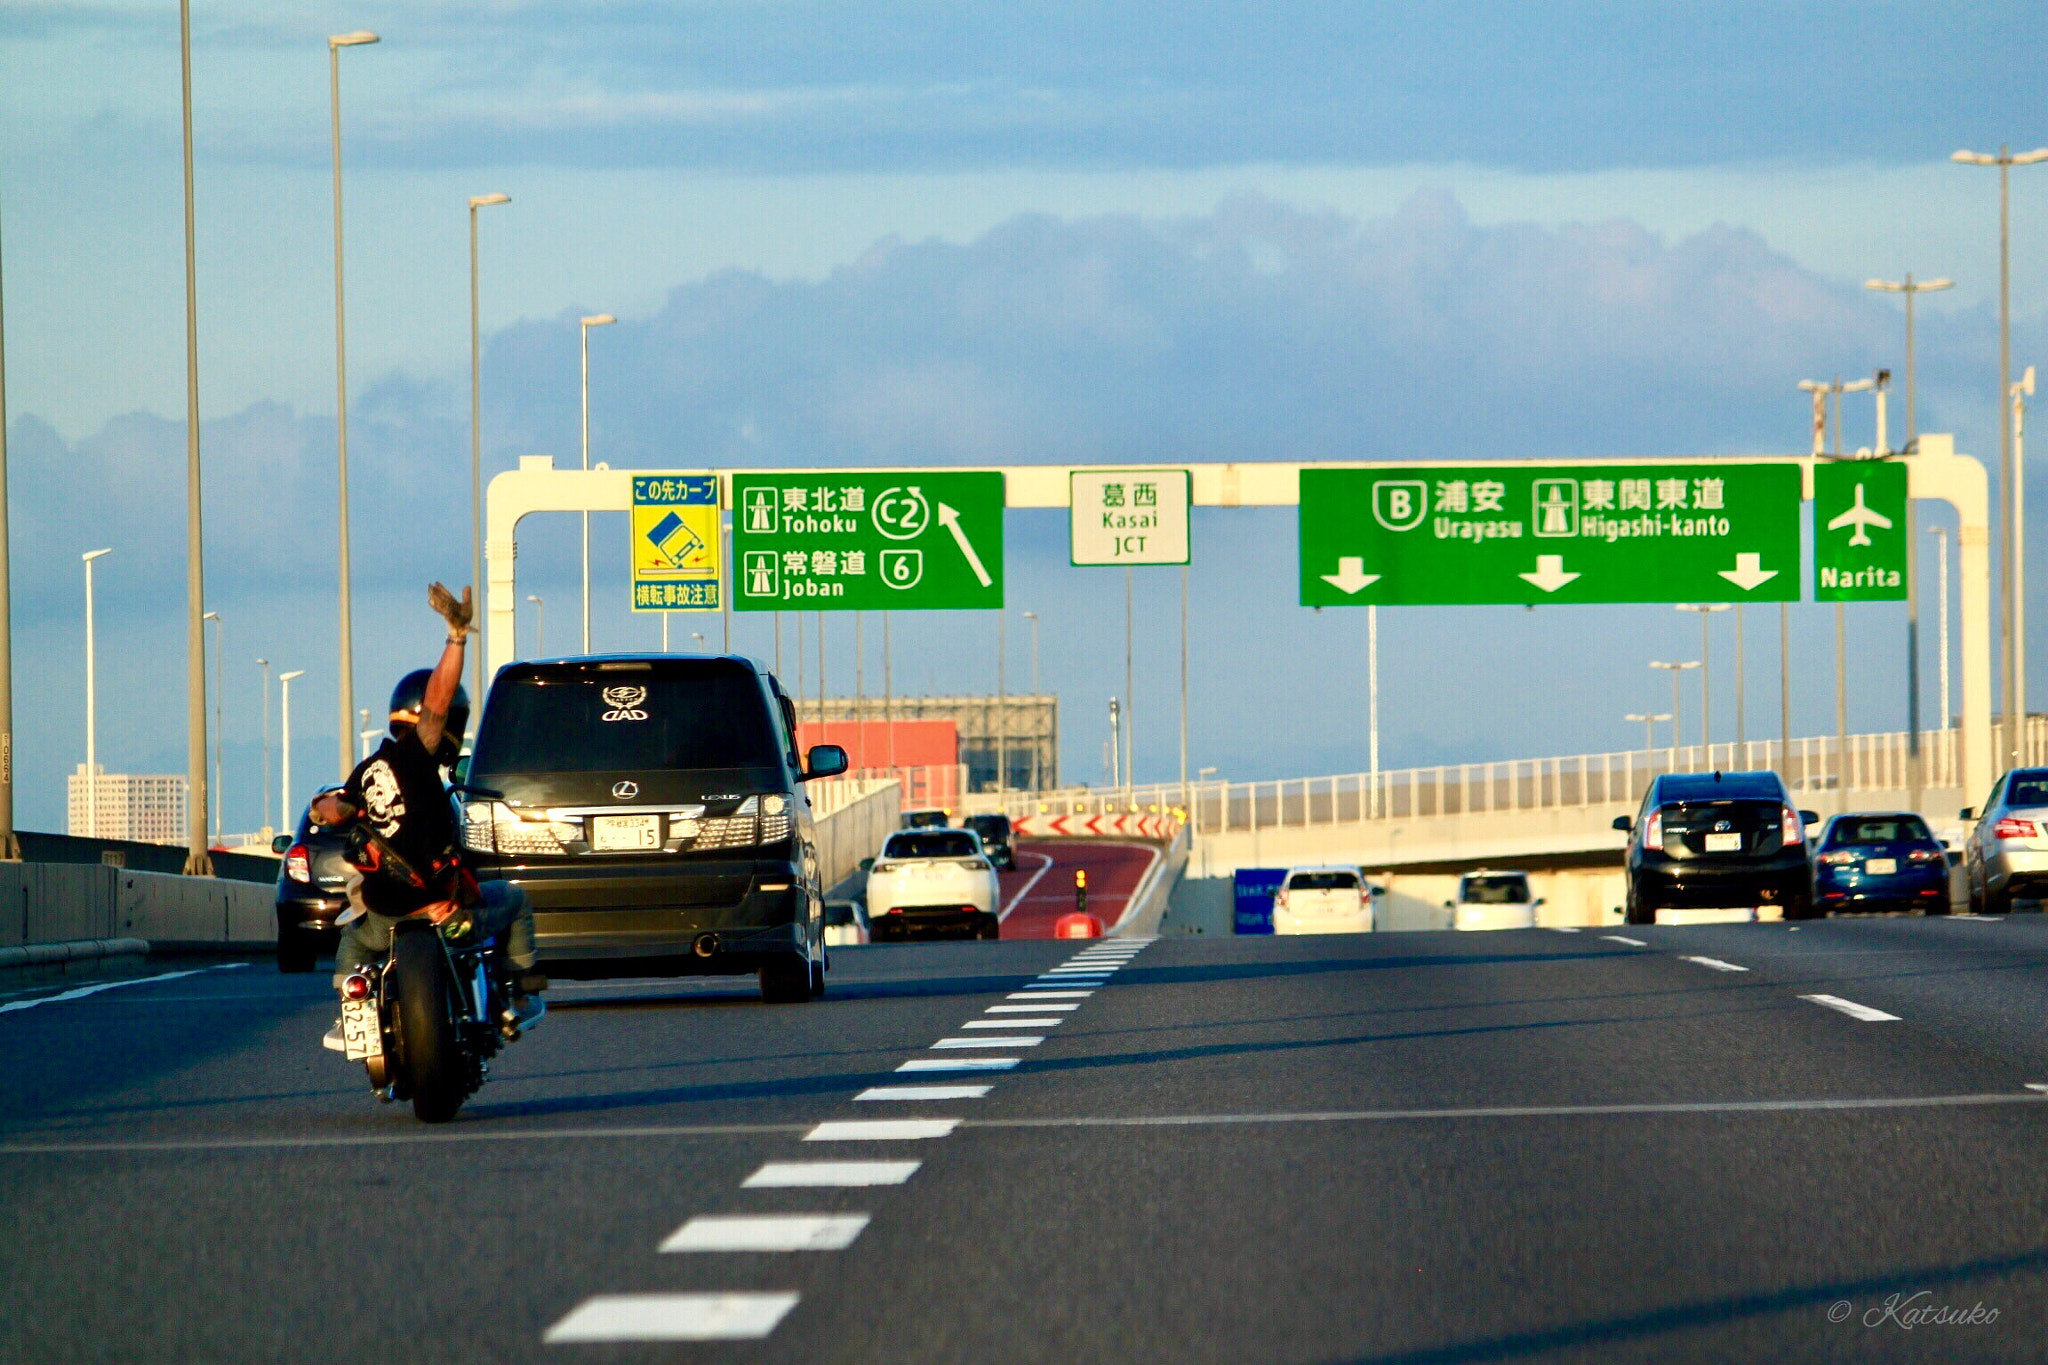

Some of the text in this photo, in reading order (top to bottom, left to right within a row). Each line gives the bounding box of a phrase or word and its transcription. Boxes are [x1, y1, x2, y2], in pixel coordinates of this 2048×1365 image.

[635, 479, 716, 500] この先カーブ
[782, 486, 865, 512] 東北道
[1101, 482, 1157, 507] 葛西
[1434, 479, 1505, 513] 浦安
[1581, 477, 1725, 511] 東関東道
[880, 499, 919, 528] C2
[1390, 489, 1412, 520] B
[782, 514, 857, 533] Tohoku
[1103, 510, 1158, 529] Kasai
[1434, 516, 1523, 544] Urayasu
[1581, 513, 1731, 542] Higashi-kanto
[1114, 536, 1148, 556] JCT
[783, 550, 866, 576] 常磐道
[893, 556, 910, 581] 6
[783, 578, 844, 600] Joban
[1820, 565, 1901, 588] Narita
[636, 584, 717, 606] 横転事故注意
